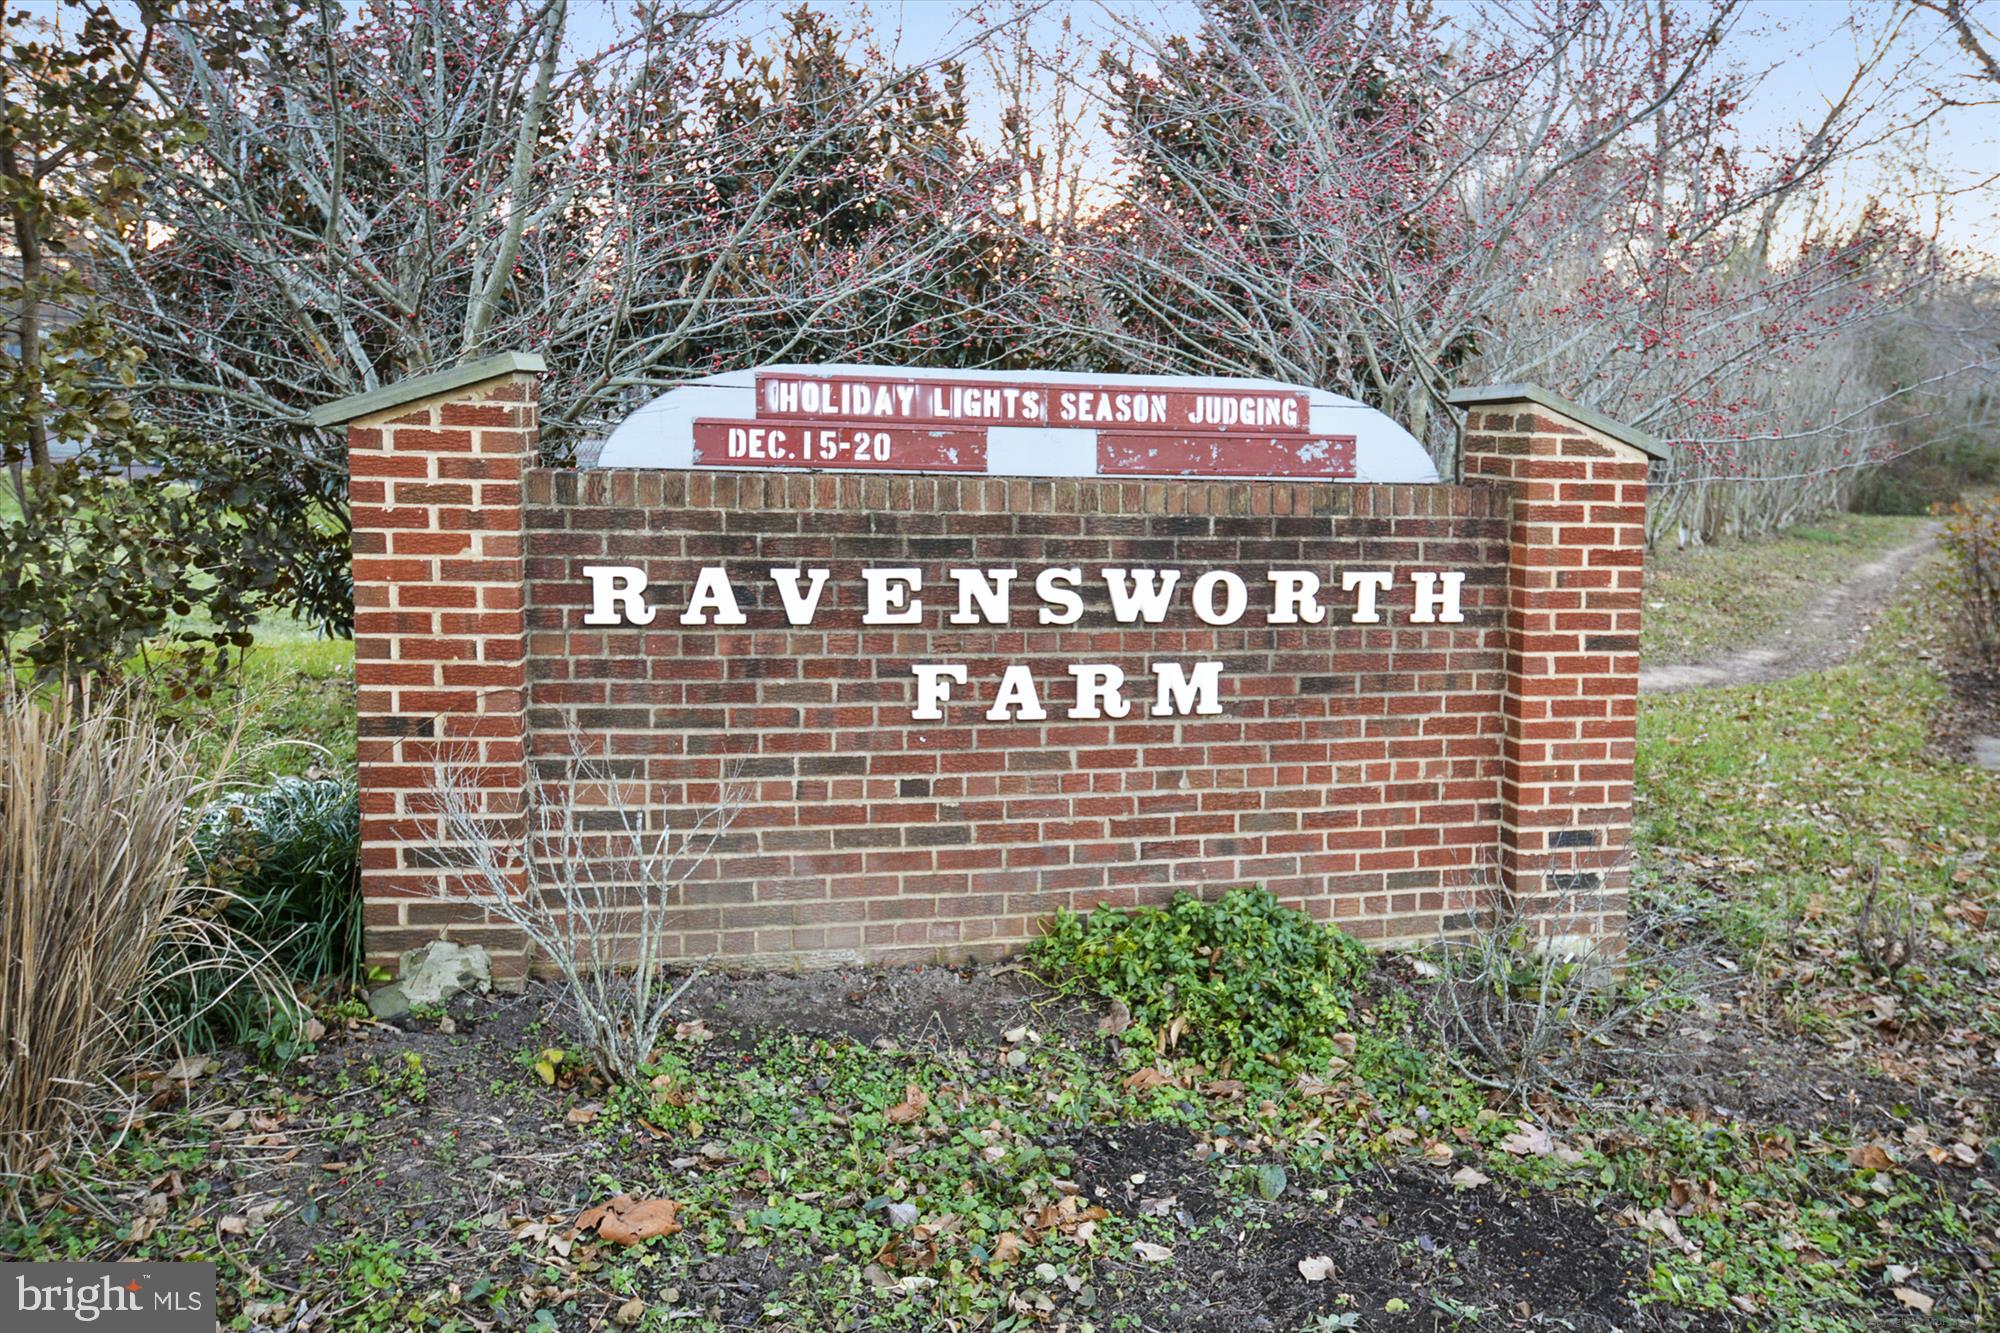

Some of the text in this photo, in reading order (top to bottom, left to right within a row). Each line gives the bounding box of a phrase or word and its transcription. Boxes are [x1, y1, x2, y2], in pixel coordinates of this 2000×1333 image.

[779, 382, 1298, 426] HOLIDAY LIGHTS SEASON JUDGING
[582, 565, 1466, 627] RAVENSWORTH
[911, 661, 1224, 721] FARM
